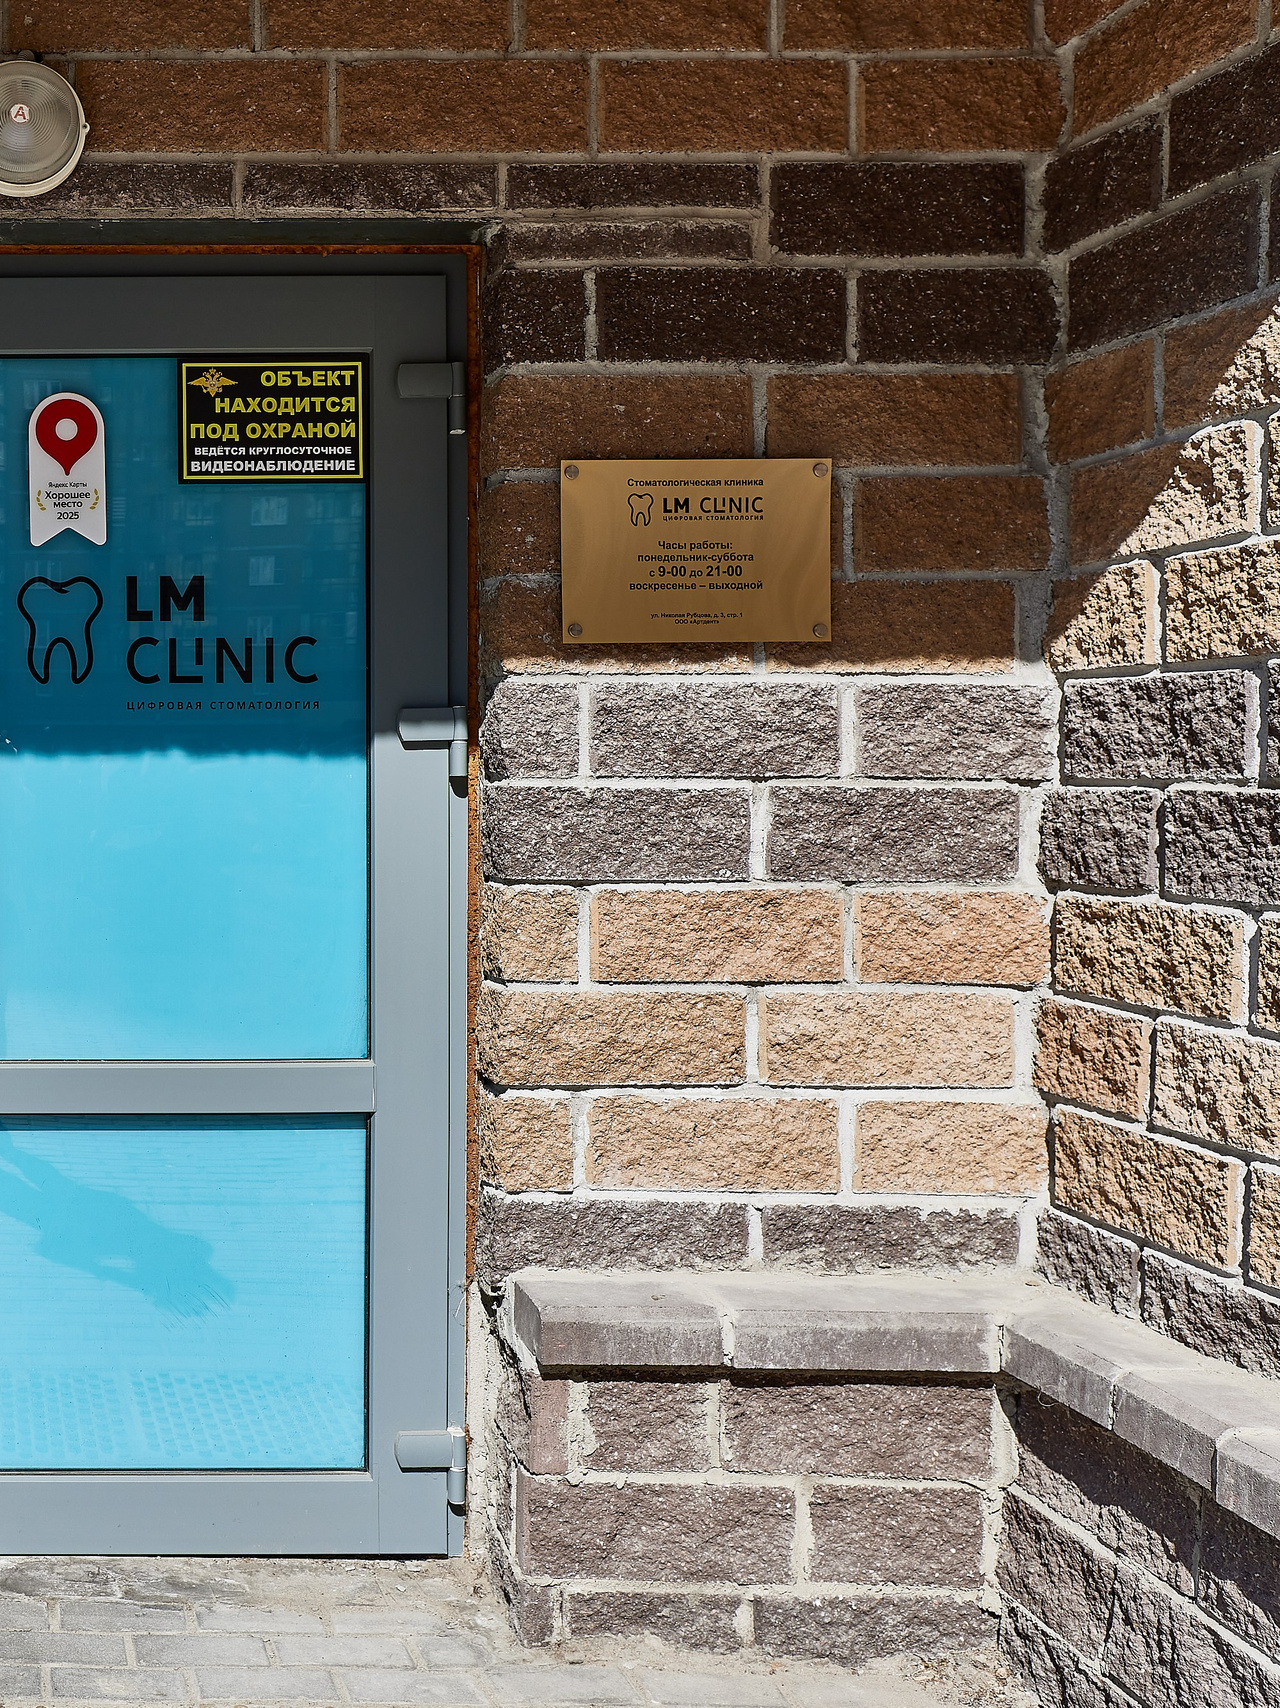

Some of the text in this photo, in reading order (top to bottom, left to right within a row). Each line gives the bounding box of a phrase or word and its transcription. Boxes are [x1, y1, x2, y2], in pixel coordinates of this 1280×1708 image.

[260, 371, 355, 387] ОБЪЕКТ
[215, 397, 356, 415] НАХОДИТСЯ
[190, 418, 356, 441] ПОД ОХРАНОЙ
[194, 445, 352, 456] ВЕДЁТСЯ КРУГЛОСУТОЧНОЕ
[190, 460, 356, 474] ВИДЕОНАБЛЮДЕНИЕ
[627, 479, 721, 487] Стоматологическая
[45, 490, 91, 501] Хорошее
[663, 496, 763, 513] LM CLINIC
[57, 512, 79, 520] 2025
[658, 540, 733, 551] Часы работы:
[637, 553, 754, 563] понедельник-суббота
[658, 565, 687, 577] 9-00
[706, 565, 743, 577] 21-00
[629, 583, 697, 592] воскресенье
[708, 580, 763, 591] выходной
[126, 575, 205, 621] LM
[126, 636, 319, 685] CLINIC
[126, 700, 320, 711] ЦИФРОВАЯ СТОМАТОЛОГИЯ
